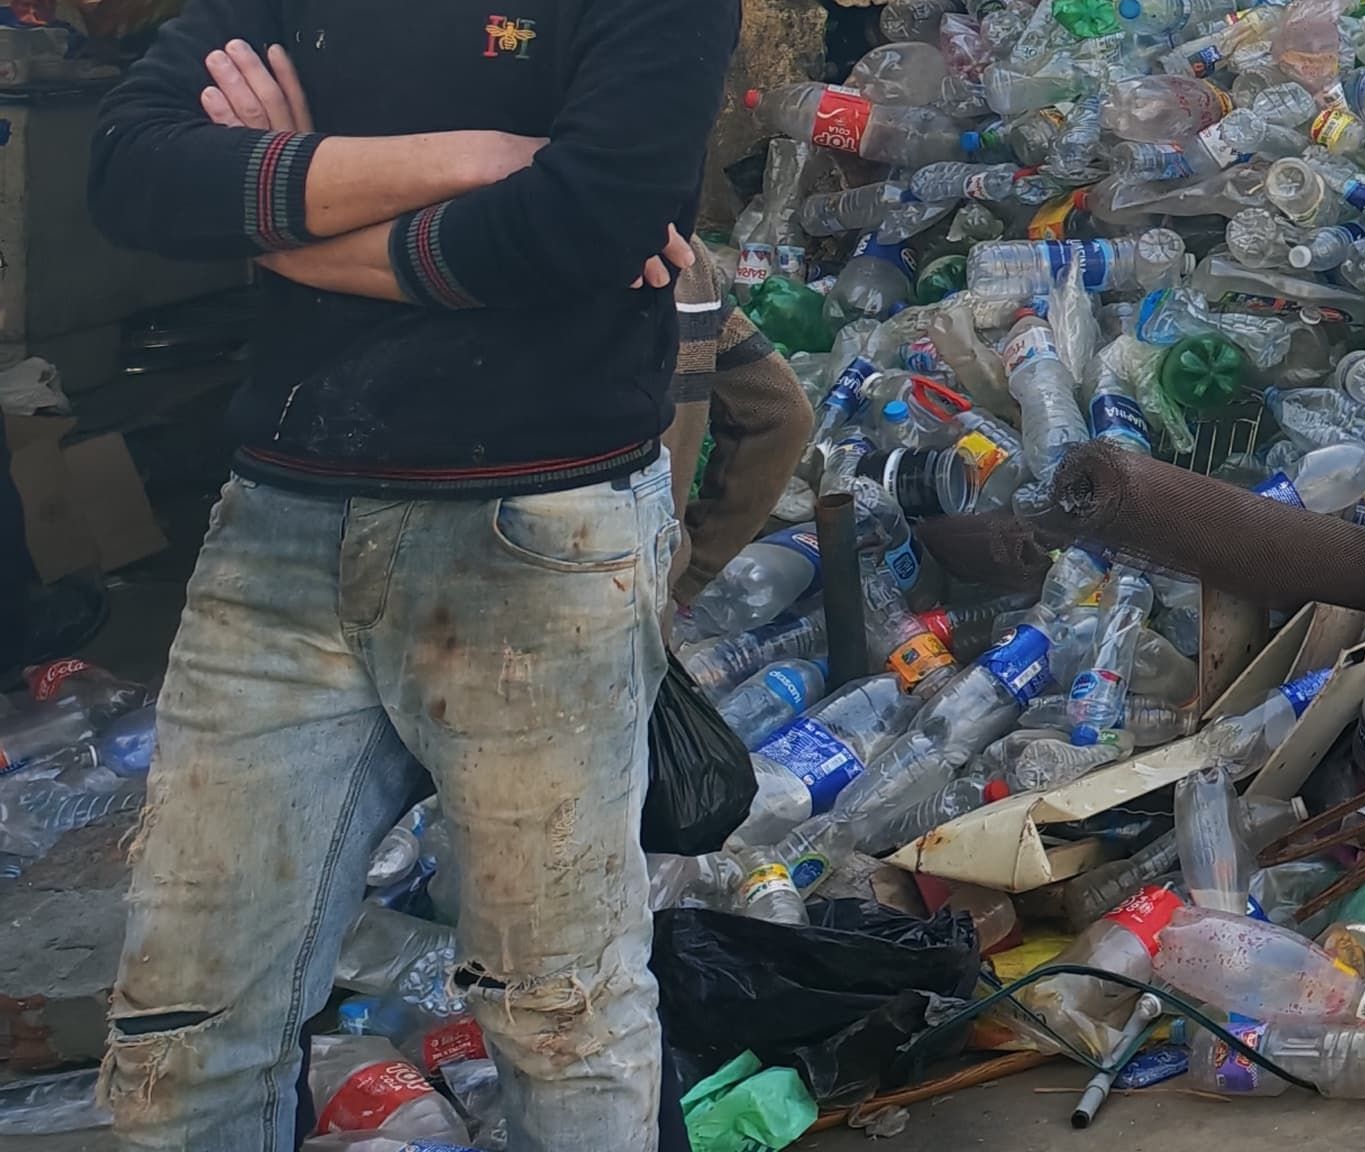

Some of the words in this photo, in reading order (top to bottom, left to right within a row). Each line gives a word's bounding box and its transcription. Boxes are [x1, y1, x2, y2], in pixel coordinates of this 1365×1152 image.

[828, 126, 851, 137] COLA
[813, 135, 858, 153] TOP
[768, 669, 803, 705] dasani
[385, 1062, 435, 1092] TOP
